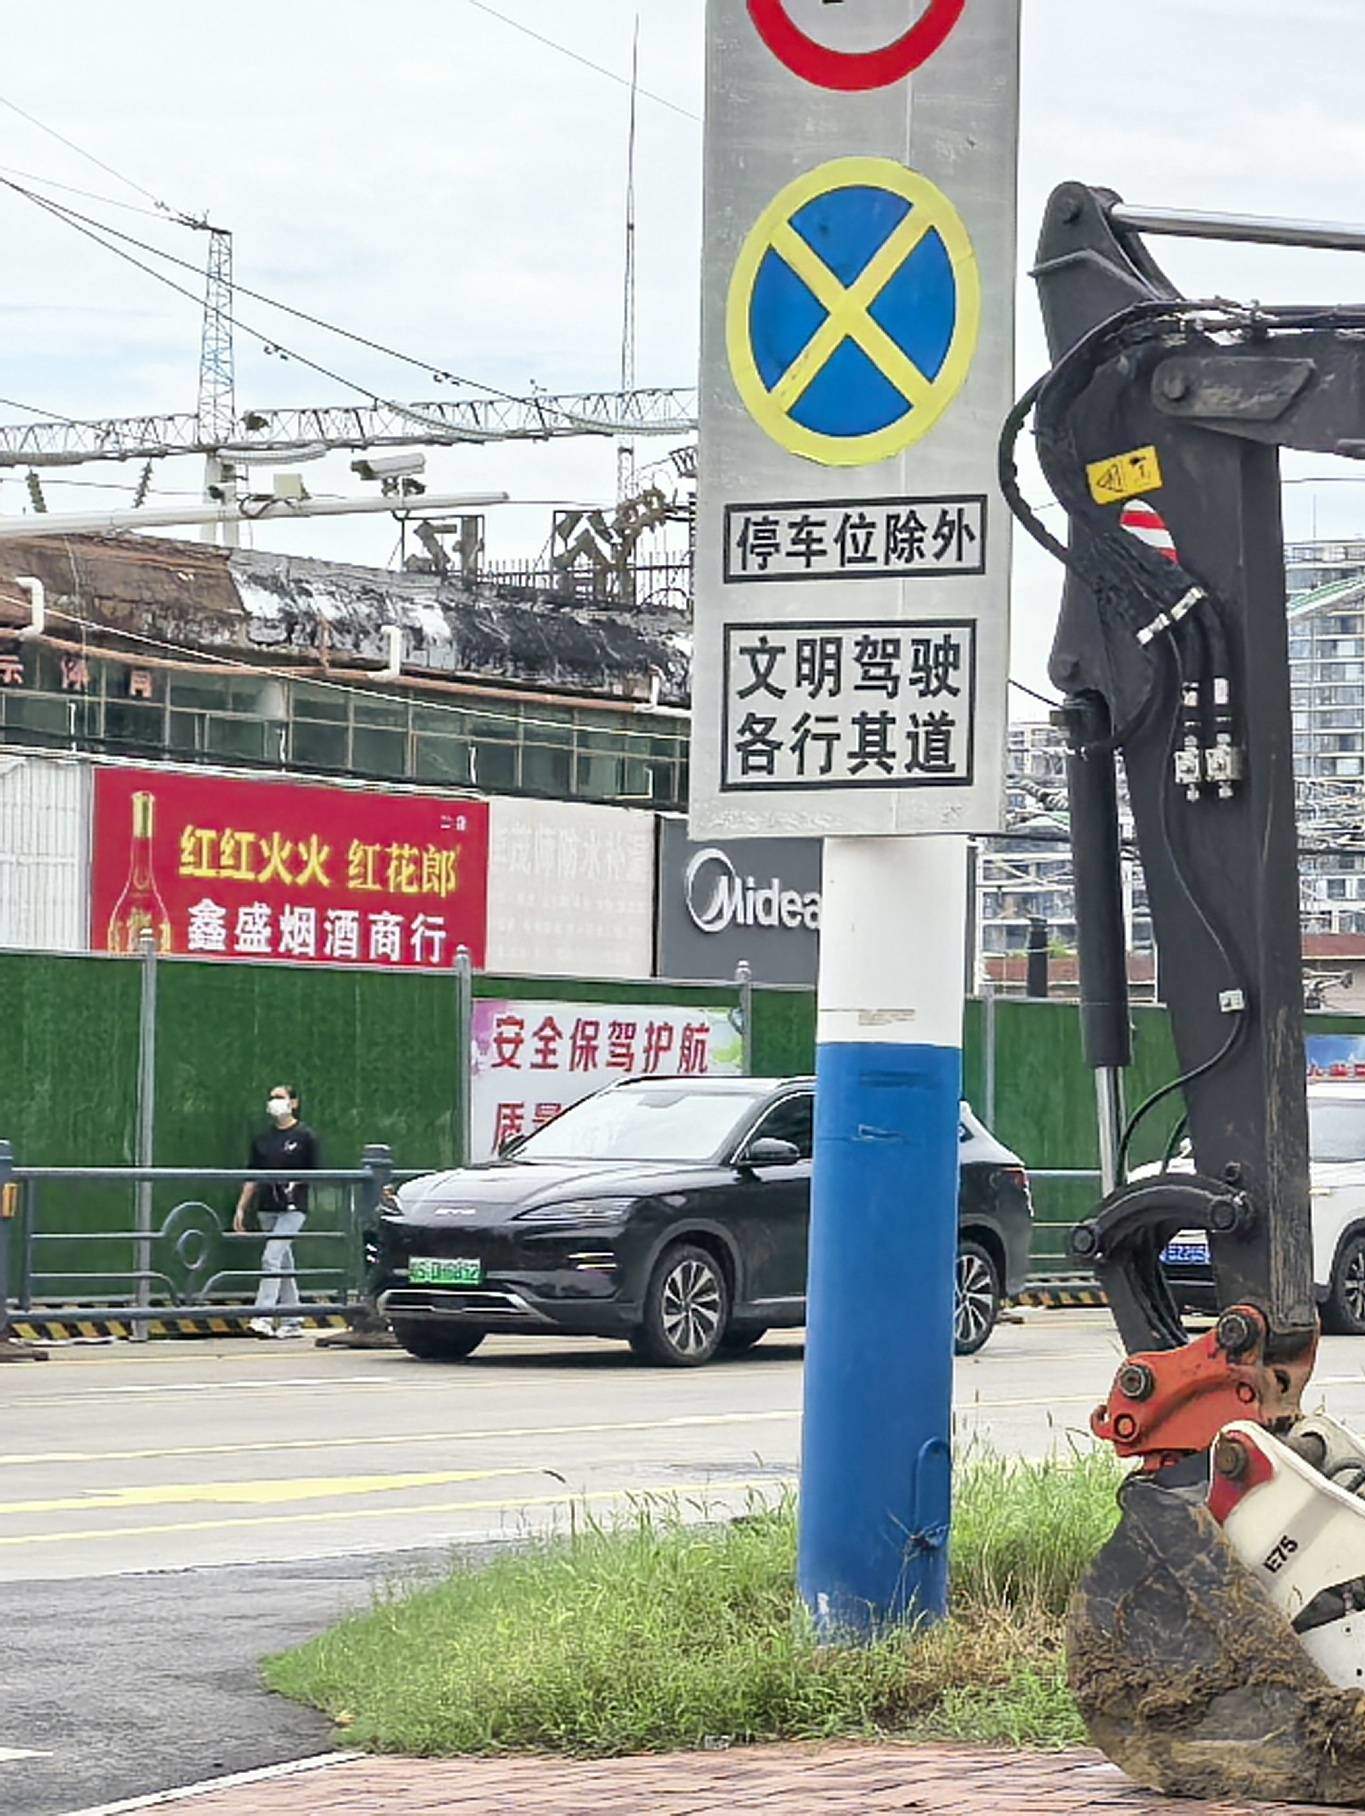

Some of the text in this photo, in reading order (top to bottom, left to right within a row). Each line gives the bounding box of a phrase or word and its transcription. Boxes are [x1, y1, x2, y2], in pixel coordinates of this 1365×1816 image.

[736, 508, 977, 571] 停车位除外
[737, 634, 961, 700] 文明驾驶
[735, 711, 957, 777] 各行其道
[179, 825, 459, 897] 红红火火 红花郎
[694, 862, 820, 932] Midea
[187, 899, 447, 964] 鑫盛烟酒商行
[491, 1015, 710, 1074] 安全保驾护航
[1262, 1535, 1299, 1573] E75
